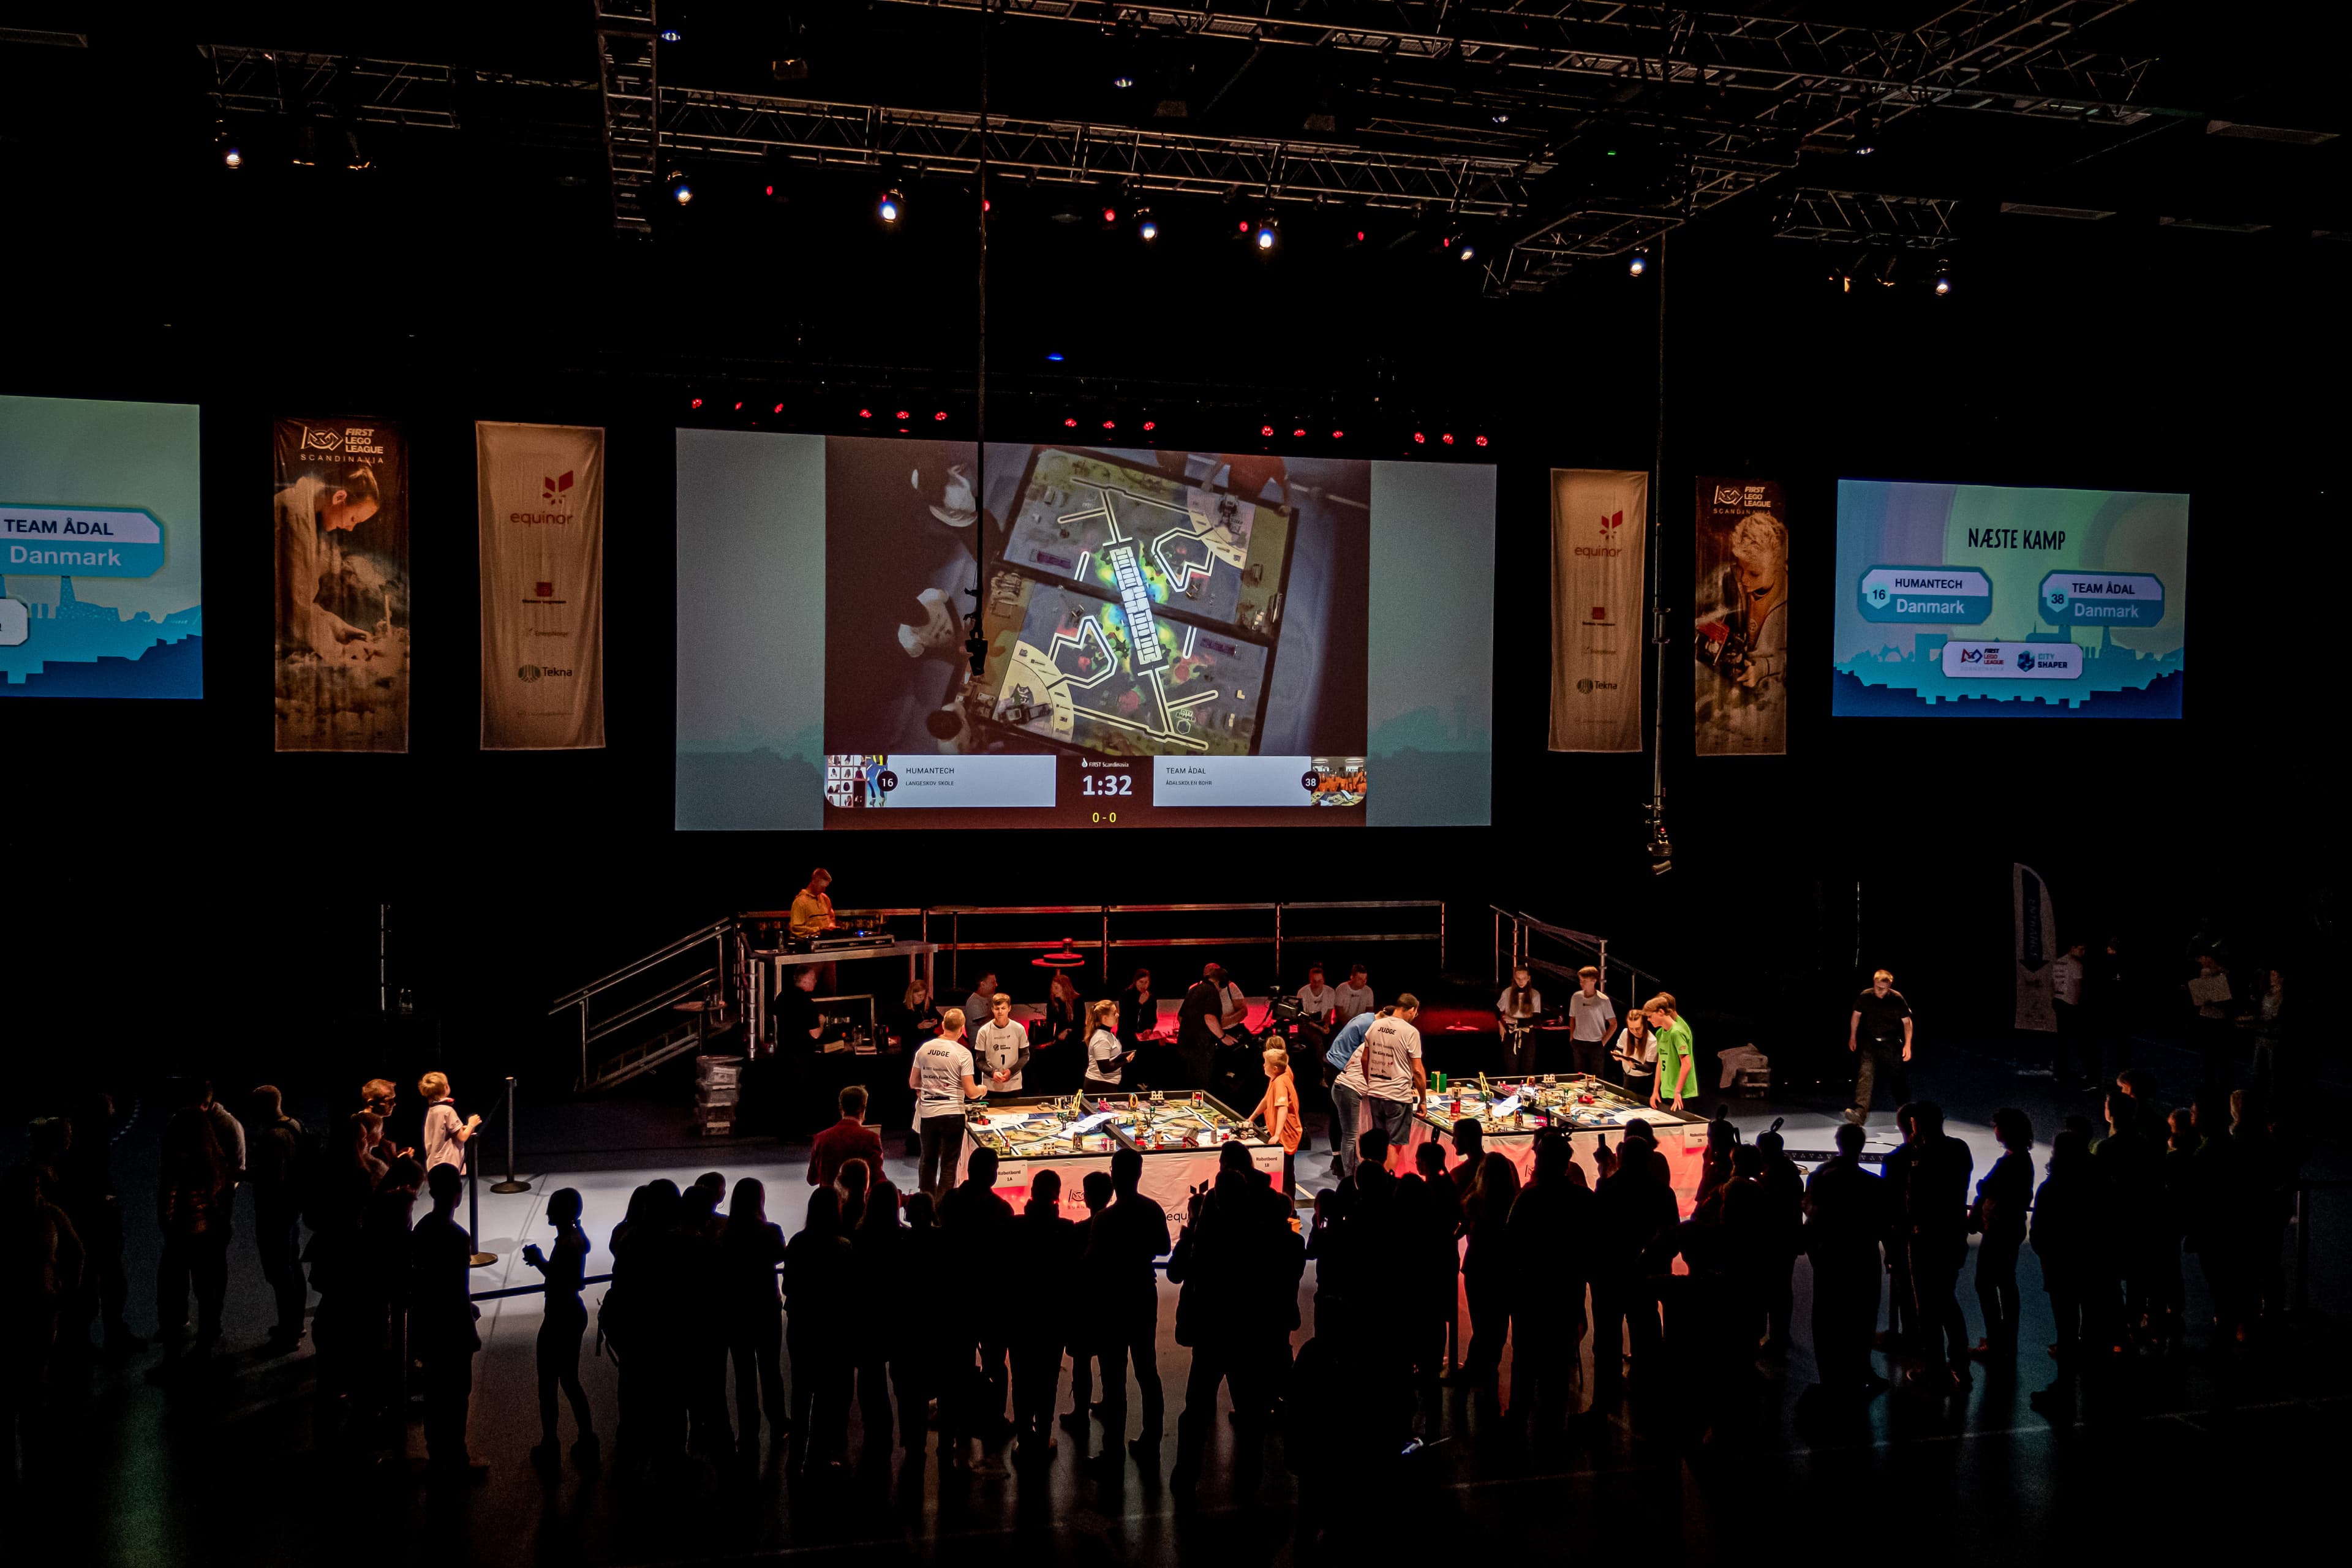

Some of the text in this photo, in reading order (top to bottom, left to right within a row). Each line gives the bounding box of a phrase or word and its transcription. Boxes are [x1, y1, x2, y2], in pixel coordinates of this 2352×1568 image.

[345, 428, 375, 436] FIRST
[345, 436, 371, 445] LEGO
[345, 445, 384, 454] LEAGUE
[300, 454, 384, 464] SCANDINAVIA
[510, 511, 573, 527] equinor
[4, 517, 114, 536] TEAM ÅDAL
[1968, 528, 2066, 550] NÆSTE KAMP
[10, 546, 122, 567] Danmark
[1575, 545, 1623, 559] equinor
[1895, 578, 1963, 589] HUMANTECH
[2072, 581, 2136, 595] TEAM ÅDAL
[1872, 589, 1886, 600] 16
[2051, 594, 2065, 605] 38
[1896, 598, 1965, 614] Danmark
[2075, 603, 2139, 619] Danmark
[542, 666, 573, 677] Tekna
[1594, 680, 1618, 690] Tekna
[1188, 766, 1206, 774] ÅDAL
[882, 778, 894, 787] 16
[1083, 775, 1133, 796] 1:32
[1305, 778, 1316, 786] 38
[1092, 812, 1099, 823] 0
[1109, 812, 1117, 823] 0
[1378, 1027, 1396, 1035] JUDGE
[1001, 1054, 1005, 1065] 1
[1662, 1060, 1666, 1071] 5
[1166, 1212, 1187, 1223] equ
